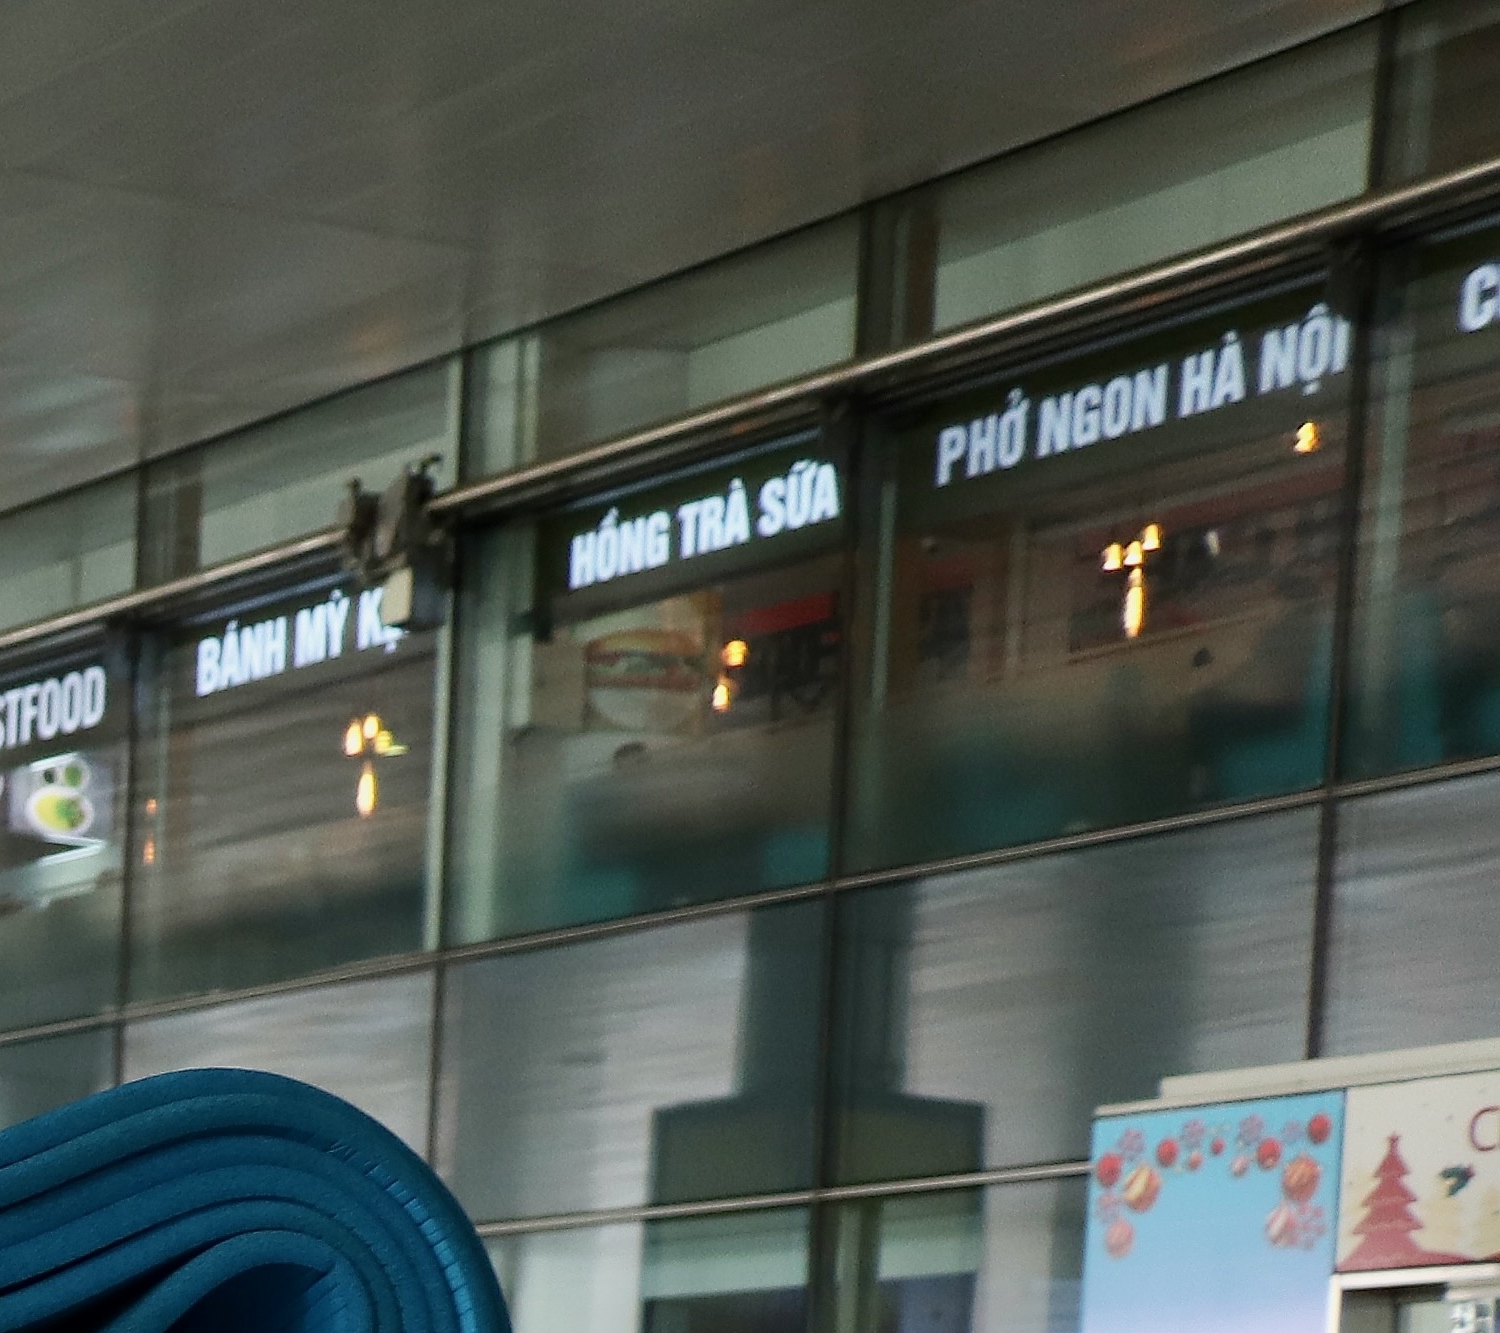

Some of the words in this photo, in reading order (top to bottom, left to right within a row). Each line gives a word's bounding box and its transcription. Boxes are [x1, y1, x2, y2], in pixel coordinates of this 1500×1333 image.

[934, 387, 1031, 488] PHỞ
[1035, 362, 1169, 460] NGON
[1178, 329, 1248, 418] HÀ
[676, 476, 751, 561] TRÀ
[194, 619, 288, 698] BÁNH
